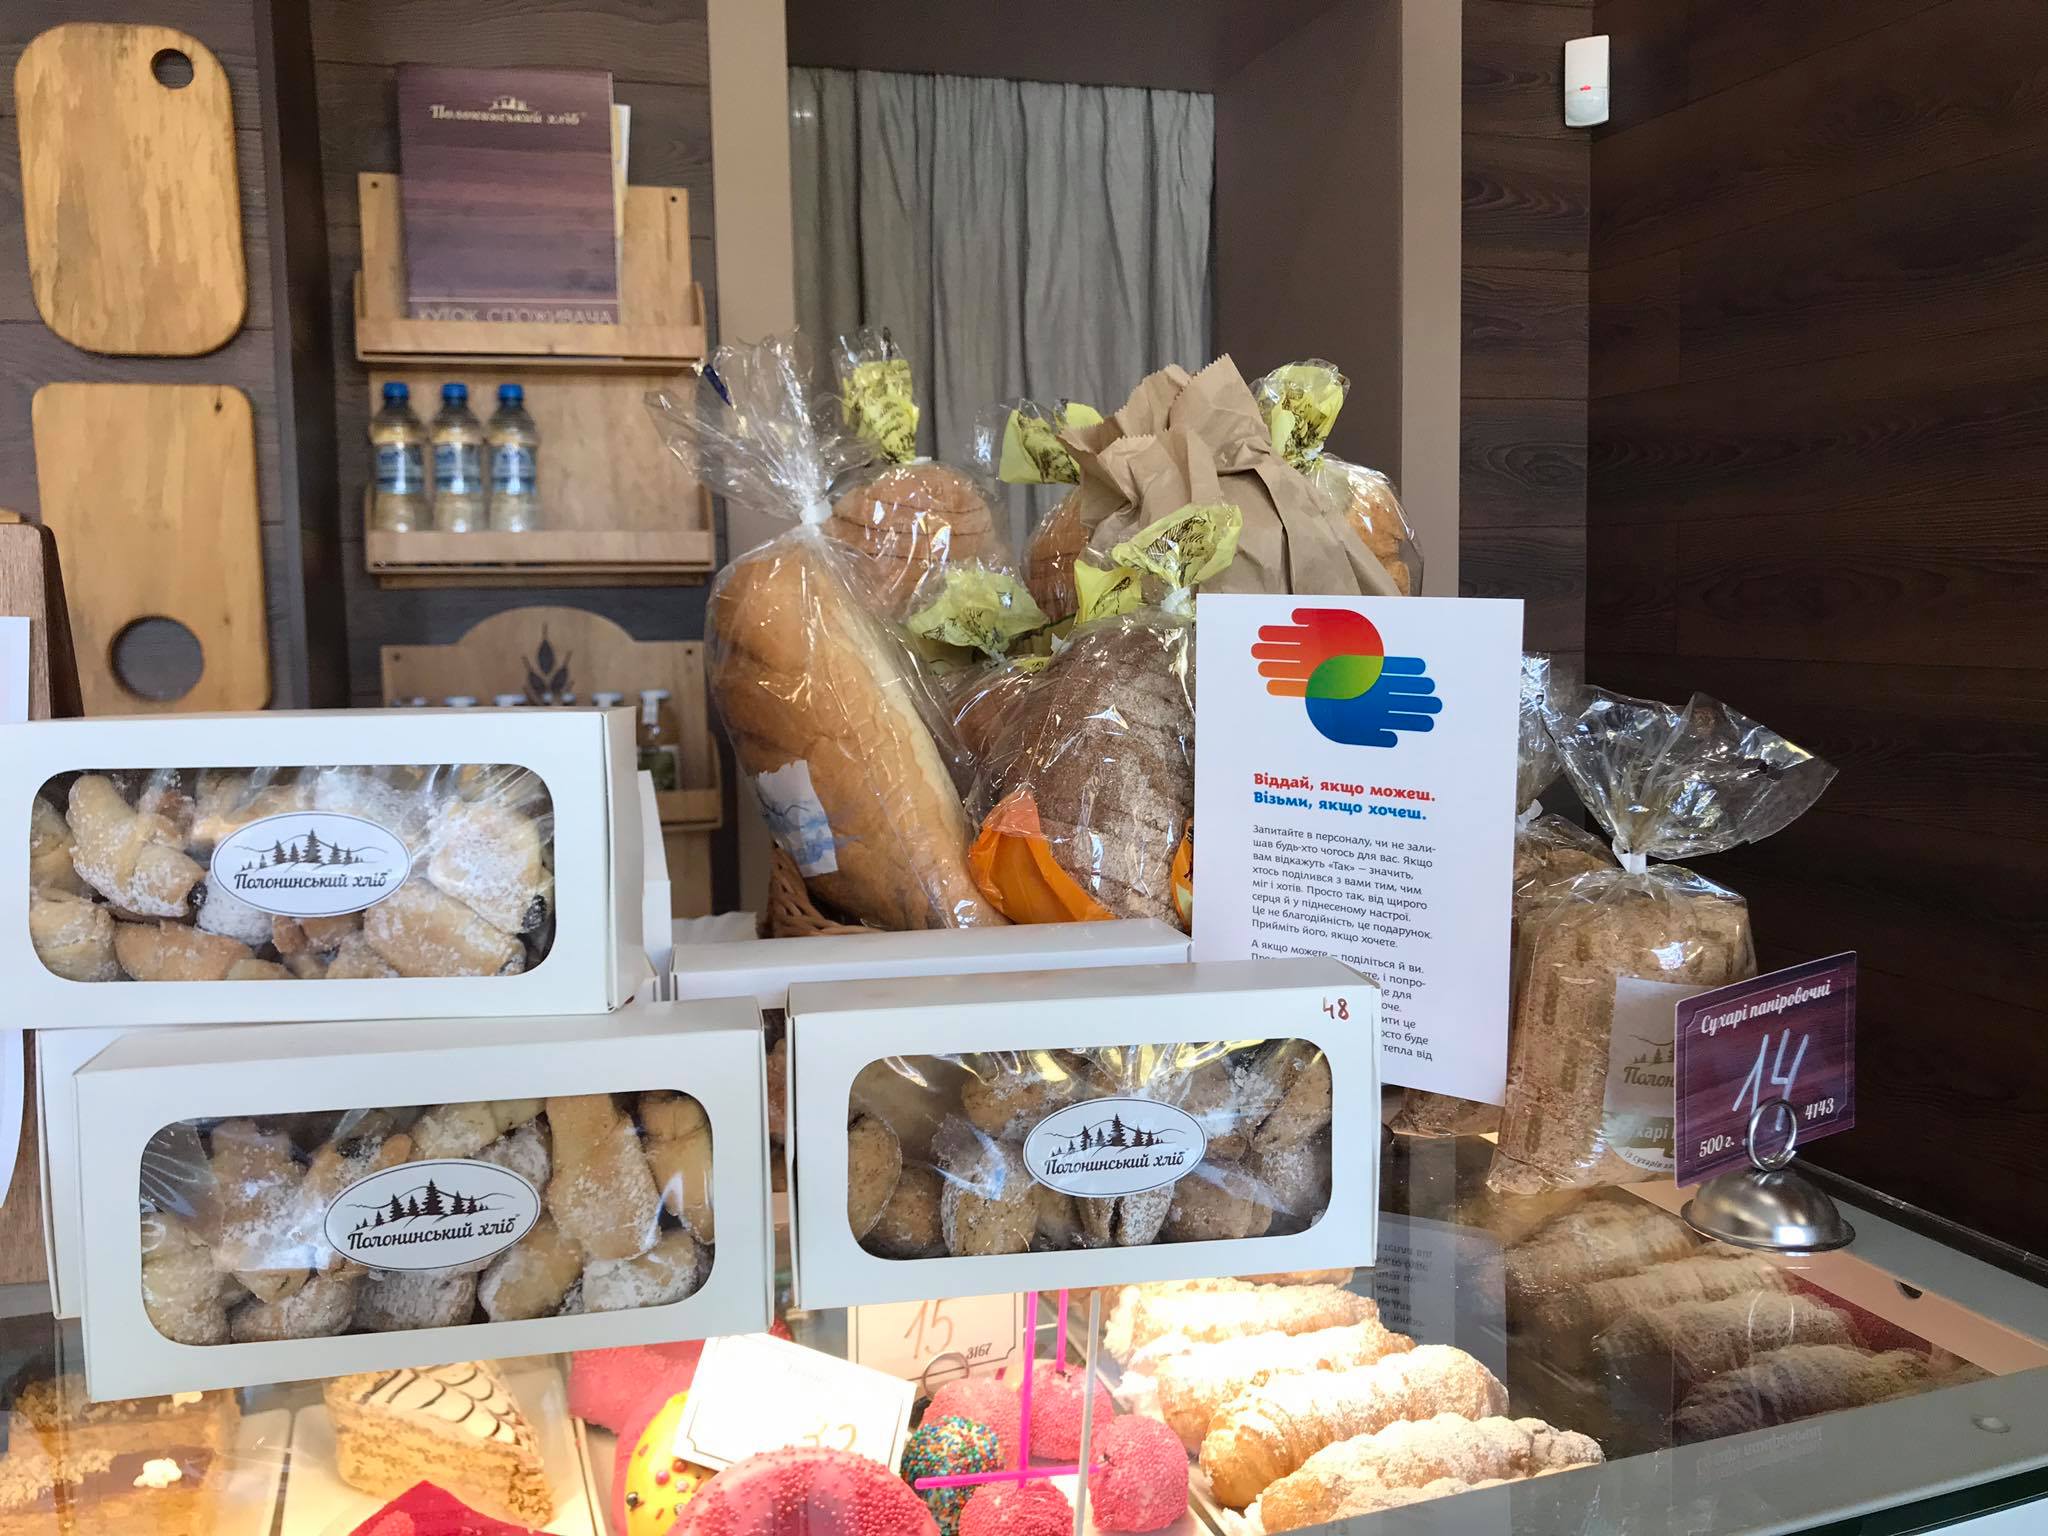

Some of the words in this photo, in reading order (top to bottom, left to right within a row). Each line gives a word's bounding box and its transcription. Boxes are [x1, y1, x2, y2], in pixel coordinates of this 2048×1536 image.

[1253, 772, 1314, 791] Віддай,
[1320, 781, 1364, 797] якщо
[1370, 786, 1435, 801] можеш.
[1253, 791, 1312, 810] Візьми,
[1318, 800, 1363, 815] якщо
[1368, 804, 1426, 820] хочеш.
[1253, 824, 1304, 838] Запитайте
[1315, 832, 1372, 848] персоналу,
[1375, 840, 1388, 848] чи
[1391, 841, 1405, 850] не
[1407, 843, 1436, 853] зали-
[1253, 839, 1273, 848] шав
[1275, 840, 1318, 853] будь-хто
[1320, 846, 1355, 858] чогось
[1357, 851, 1377, 861] для
[1380, 854, 1400, 864] вас.
[1403, 855, 1433, 868] Якщо
[1253, 853, 1272, 862] вам
[1275, 854, 1325, 869] відкажуть
[1328, 861, 1355, 871] «Так»
[1369, 867, 1414, 880] значить,
[234, 872, 349, 890] Полонинський
[352, 871, 389, 888] хліб
[1252, 867, 1279, 876] хтось
[1282, 870, 1333, 883] поділився
[1336, 876, 1342, 884] з
[1344, 878, 1371, 888] вами
[1375, 882, 1397, 892] тим,
[1400, 885, 1422, 895] чим
[1252, 879, 1269, 888] міг
[1276, 883, 1304, 893] хотів.
[1306, 885, 1343, 898] Просто
[1346, 892, 1365, 901] так,
[1368, 894, 1384, 905] від
[1387, 897, 1428, 910] щирого
[1252, 893, 1280, 904] серця
[1284, 895, 1290, 904] й
[1293, 899, 1299, 908] у
[1301, 899, 1367, 917] піднесеному
[1369, 909, 1411, 922] настрої.
[1252, 905, 1265, 916] Це
[1268, 908, 1280, 917] не
[1282, 909, 1355, 928] благодійність,
[1358, 921, 1370, 931] це
[1373, 923, 1432, 940] подарунок.
[1252, 919, 1300, 933] Прийміть
[1302, 926, 1328, 938] його,
[1330, 931, 1359, 944] якщо
[1361, 936, 1398, 948] хочете.
[1251, 939, 1259, 948] А
[1261, 942, 1288, 953] якщо
[1341, 953, 1395, 969] поділіться
[1398, 961, 1405, 971] й
[1408, 964, 1424, 974] ви.
[1389, 975, 1426, 988] попро-
[1392, 990, 1412, 999] для
[1322, 997, 1350, 1020] 48
[1381, 1002, 1401, 1012] оче.
[1701, 1004, 1747, 1036] Сухарі
[1749, 979, 1832, 1019] паніровочні
[1403, 1020, 1416, 1029] це
[1404, 1032, 1429, 1045] буде
[1383, 1044, 1413, 1056] тепла
[1416, 1050, 1433, 1062] від
[1732, 1028, 1810, 1131] 14
[1804, 1098, 1834, 1120] 4143
[1044, 1153, 1149, 1175] Полонинський
[1152, 1150, 1187, 1168] хліб
[347, 1221, 473, 1250] Полонинський
[477, 1218, 517, 1238] хліб
[904, 1298, 954, 1360] 15
[966, 1342, 993, 1360] 3167
